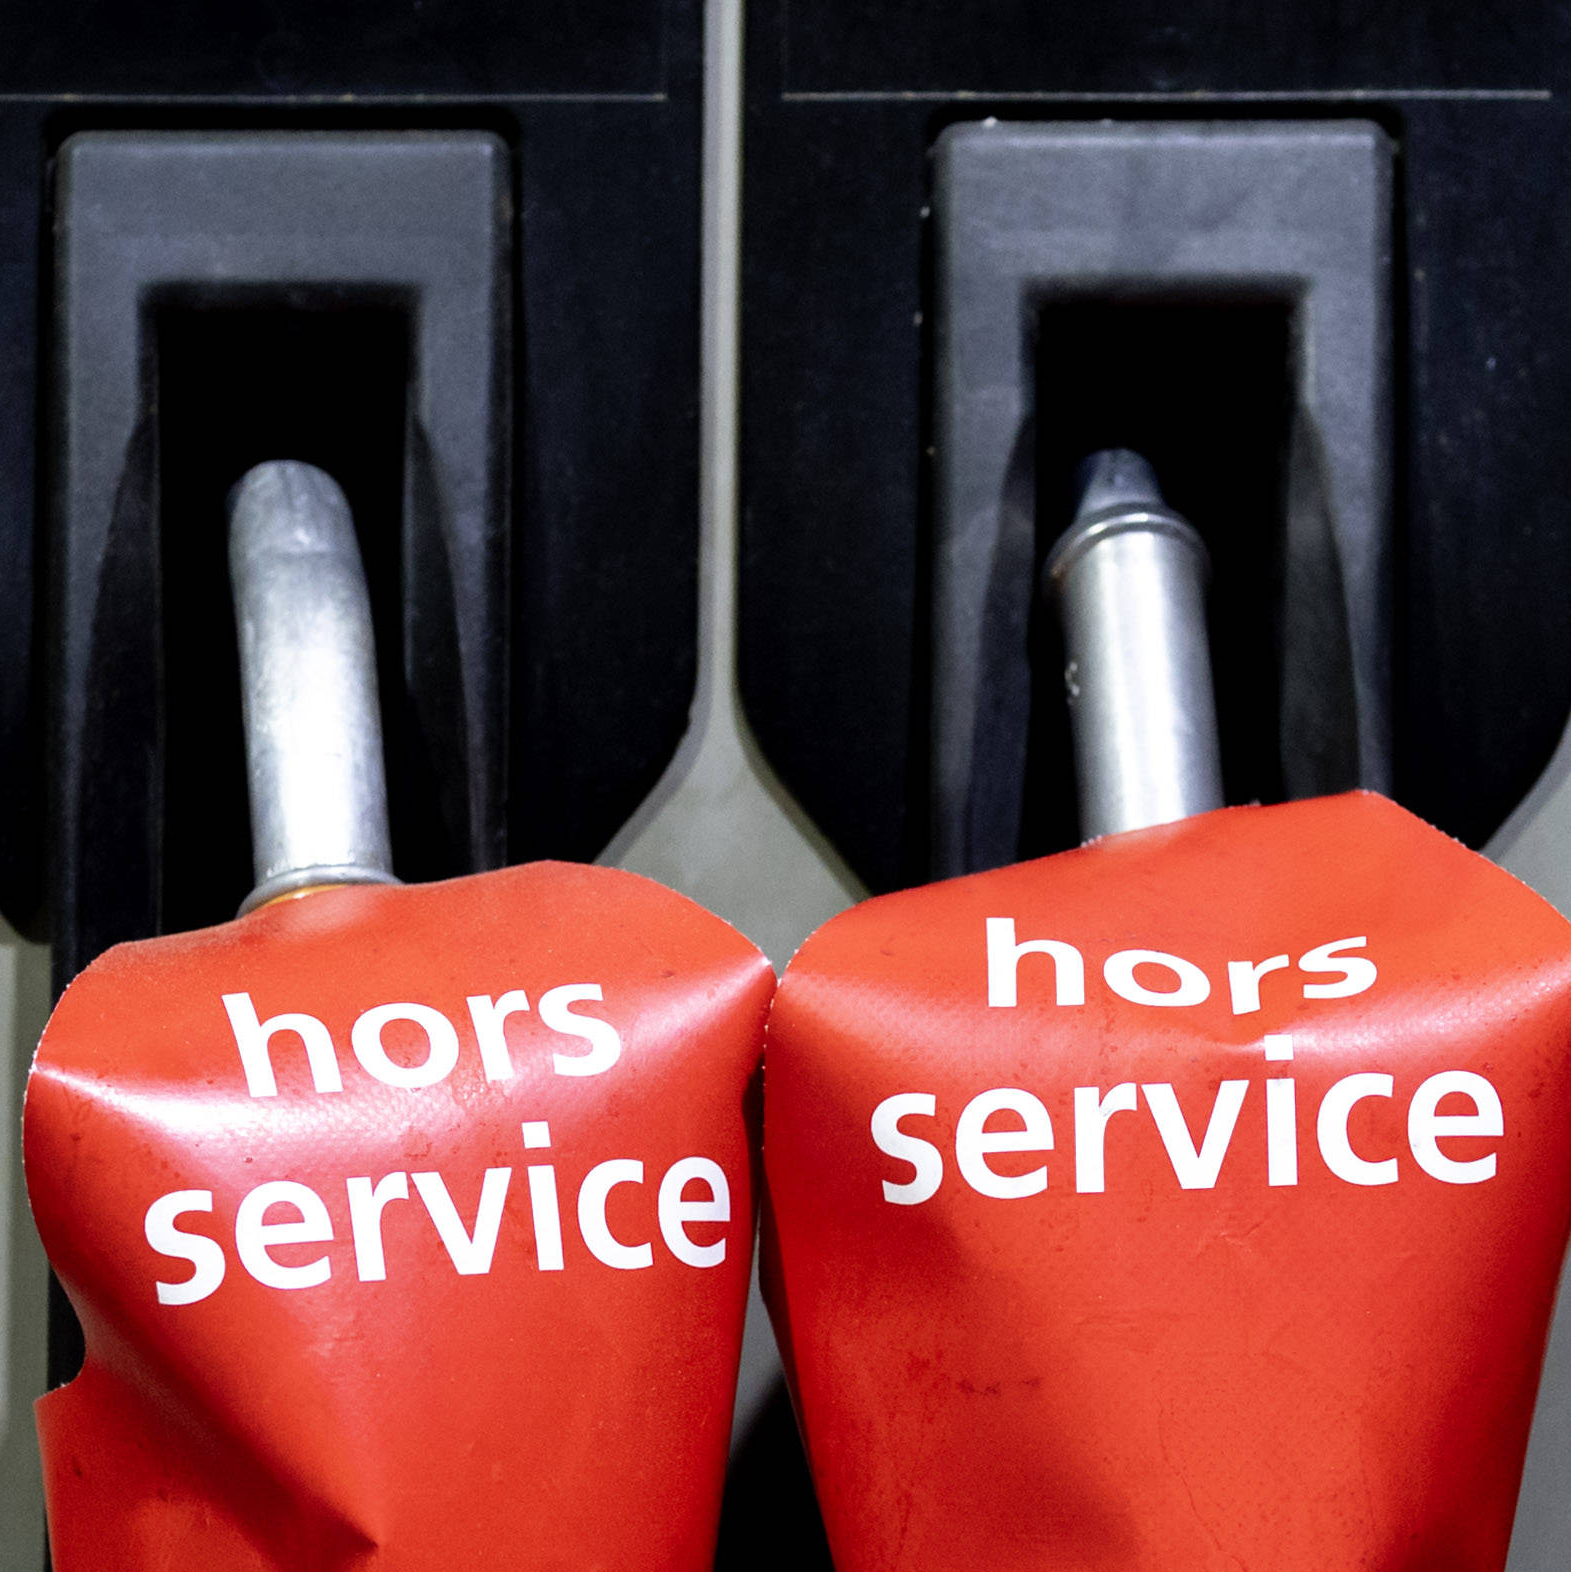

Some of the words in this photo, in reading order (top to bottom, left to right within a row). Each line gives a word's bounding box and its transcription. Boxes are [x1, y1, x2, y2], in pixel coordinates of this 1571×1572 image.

[985, 916, 1378, 1015] hors
[222, 982, 622, 1099] hors
[871, 1034, 1504, 1205] service
[145, 1119, 731, 1306] service
